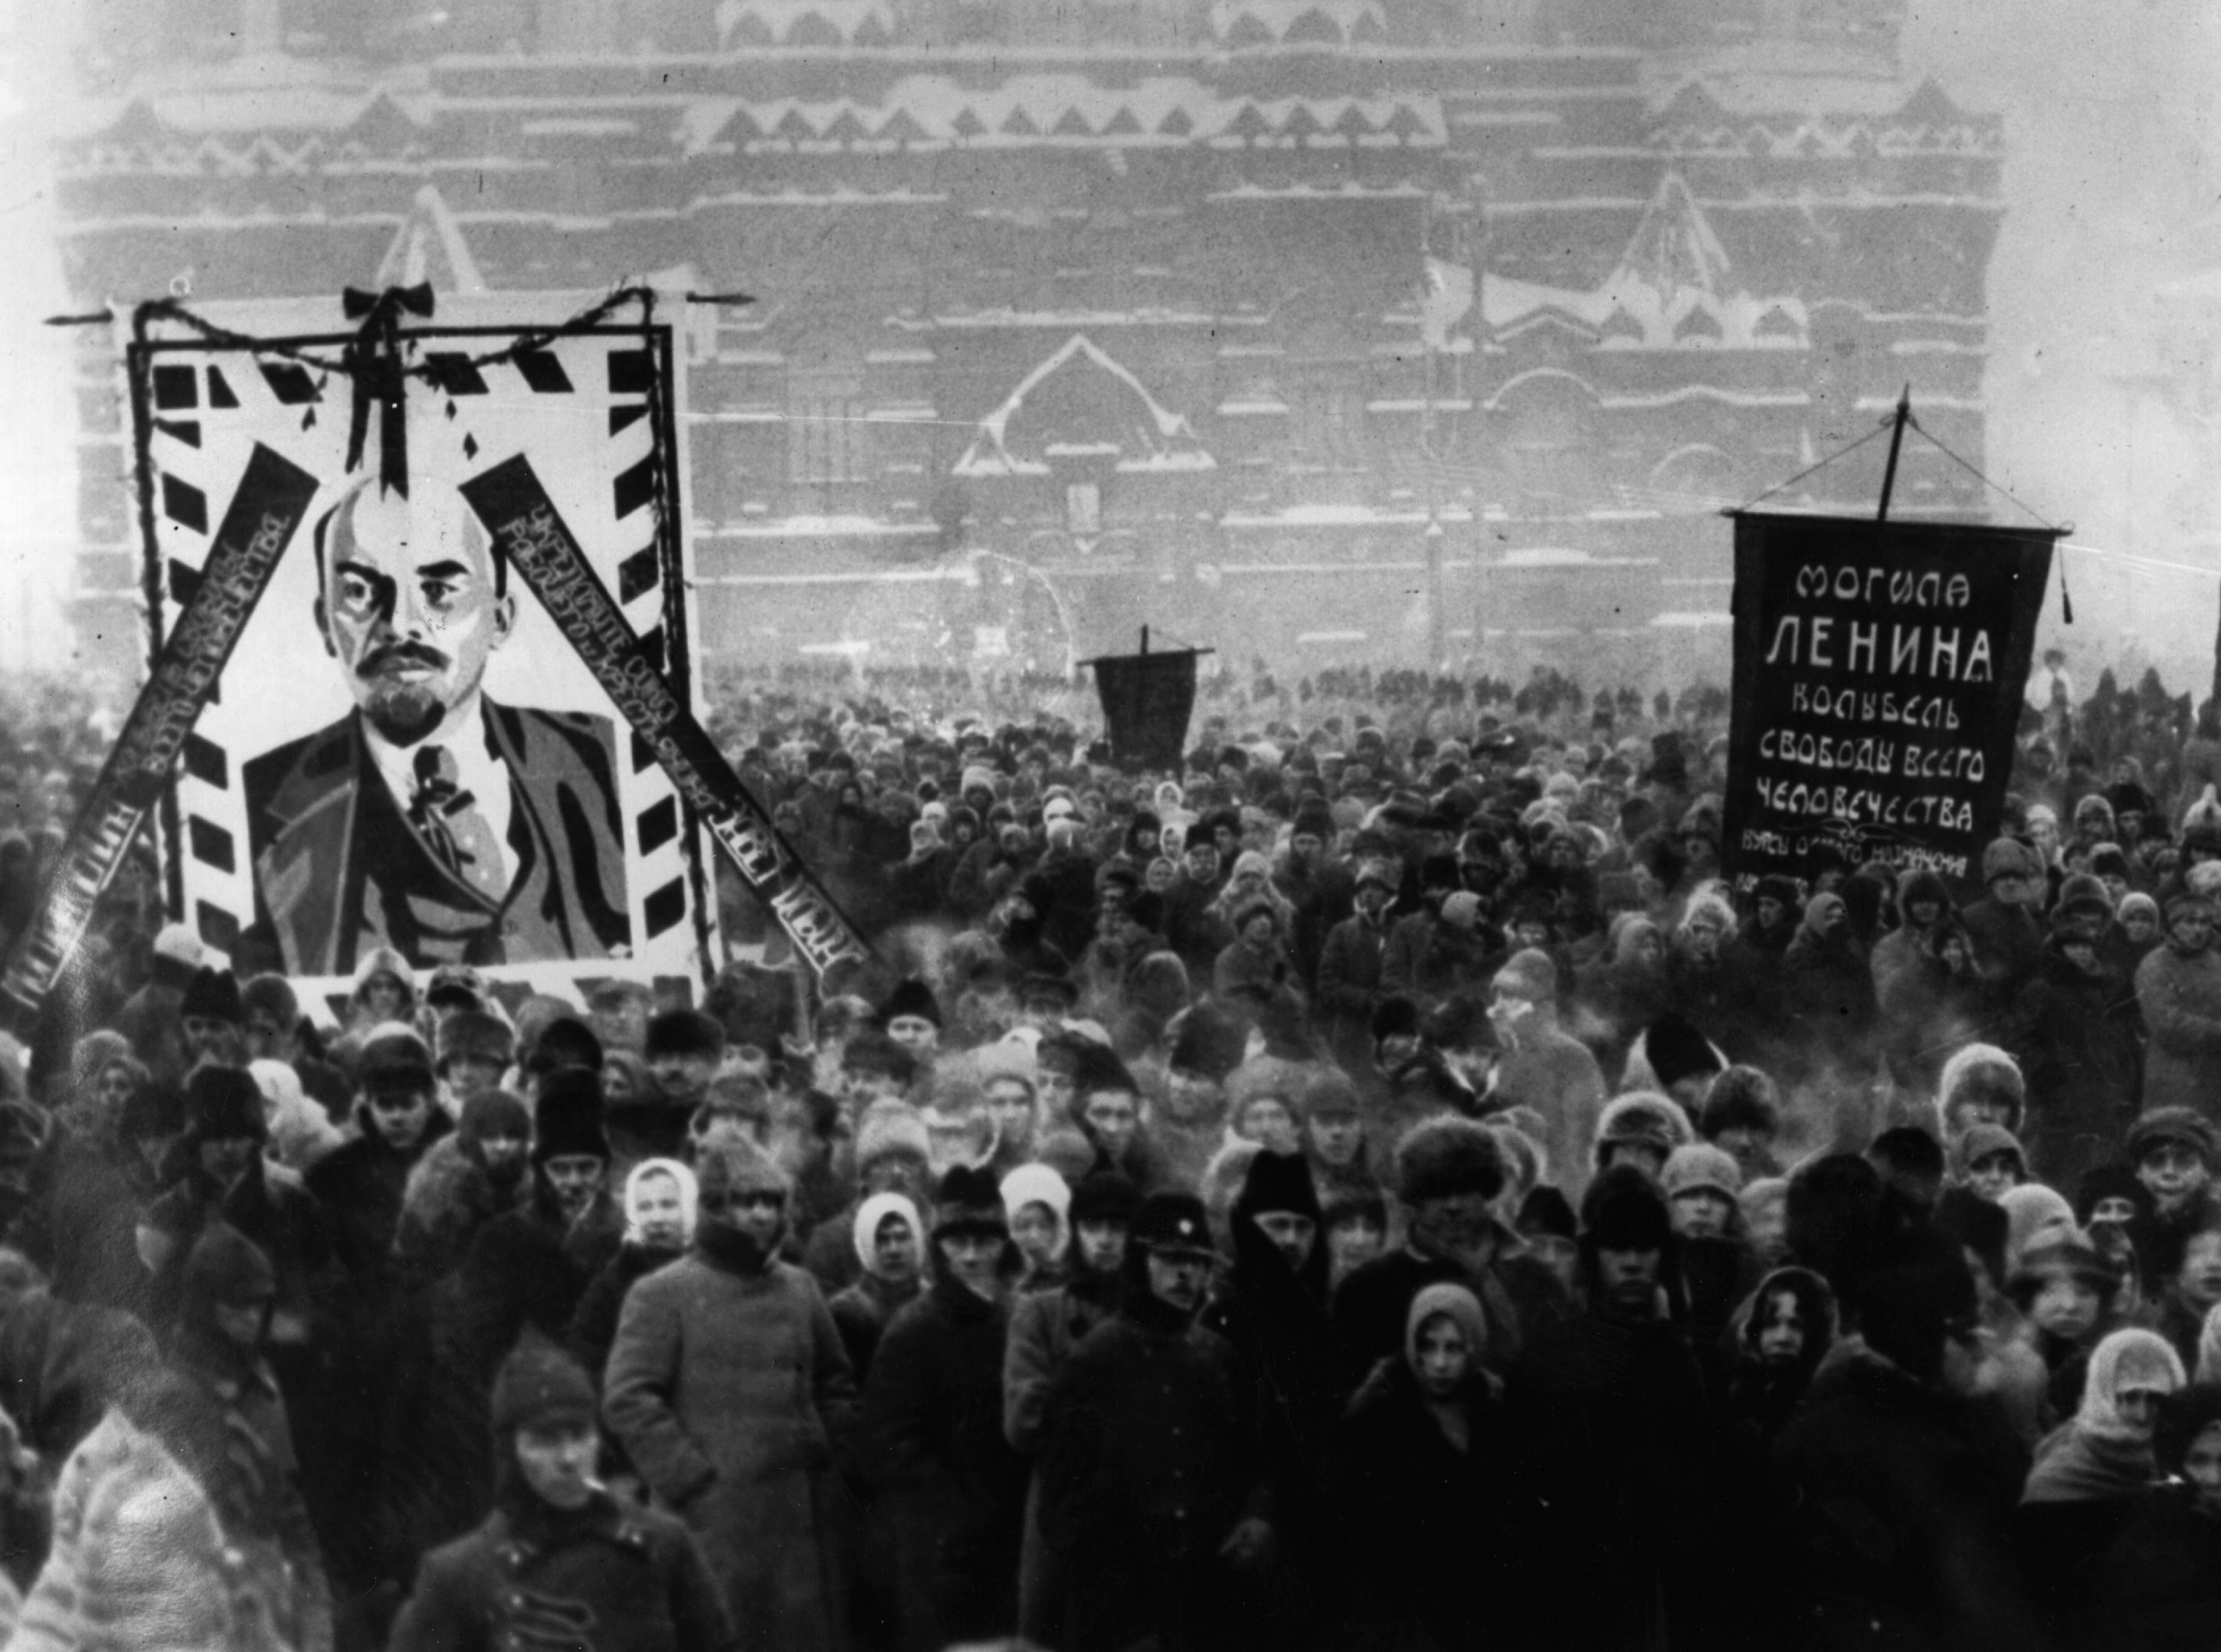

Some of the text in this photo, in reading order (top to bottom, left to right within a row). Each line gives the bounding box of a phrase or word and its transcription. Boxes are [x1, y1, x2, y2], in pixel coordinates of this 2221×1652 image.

[496, 516, 591, 638] РАБОЧЕГО
[1796, 565, 1971, 608] МОГИЛА
[1766, 615, 1992, 681] ЛЕНИНА
[624, 655, 679, 724] СОЮЗ
[1793, 682, 1960, 729] КОЛЫБЕЛЬ
[1760, 729, 1984, 782] СВОБОДЫ ВСЕГО
[1757, 776, 1974, 831] ЧЕЛОВЕЧЕСТВА
